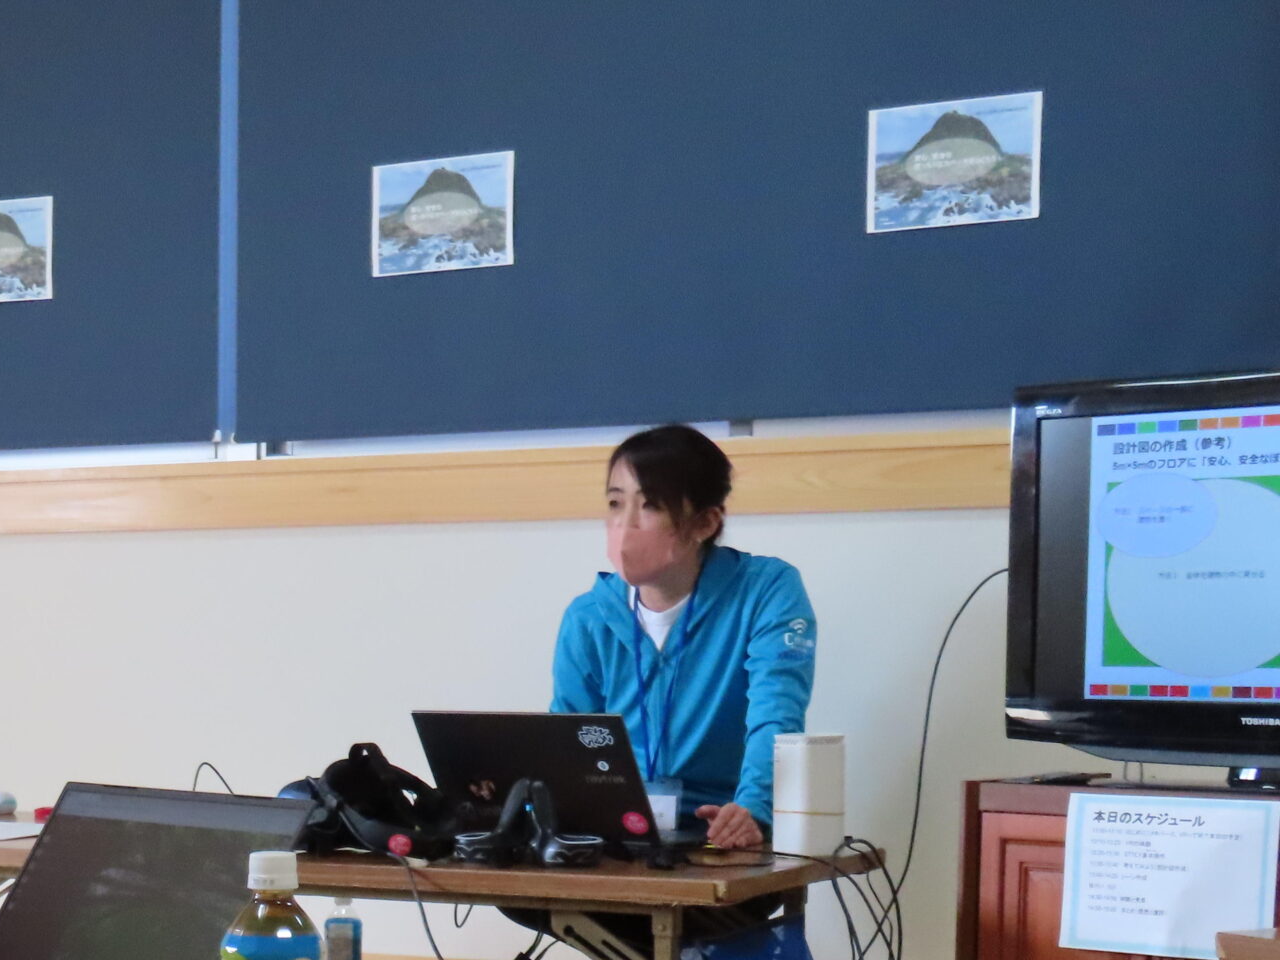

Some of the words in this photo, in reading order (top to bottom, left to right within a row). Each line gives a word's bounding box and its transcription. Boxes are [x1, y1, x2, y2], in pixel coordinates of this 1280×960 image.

[1240, 717, 1280, 726] TOSHIBA
[1093, 810, 1206, 828] 本日のスケジュール
